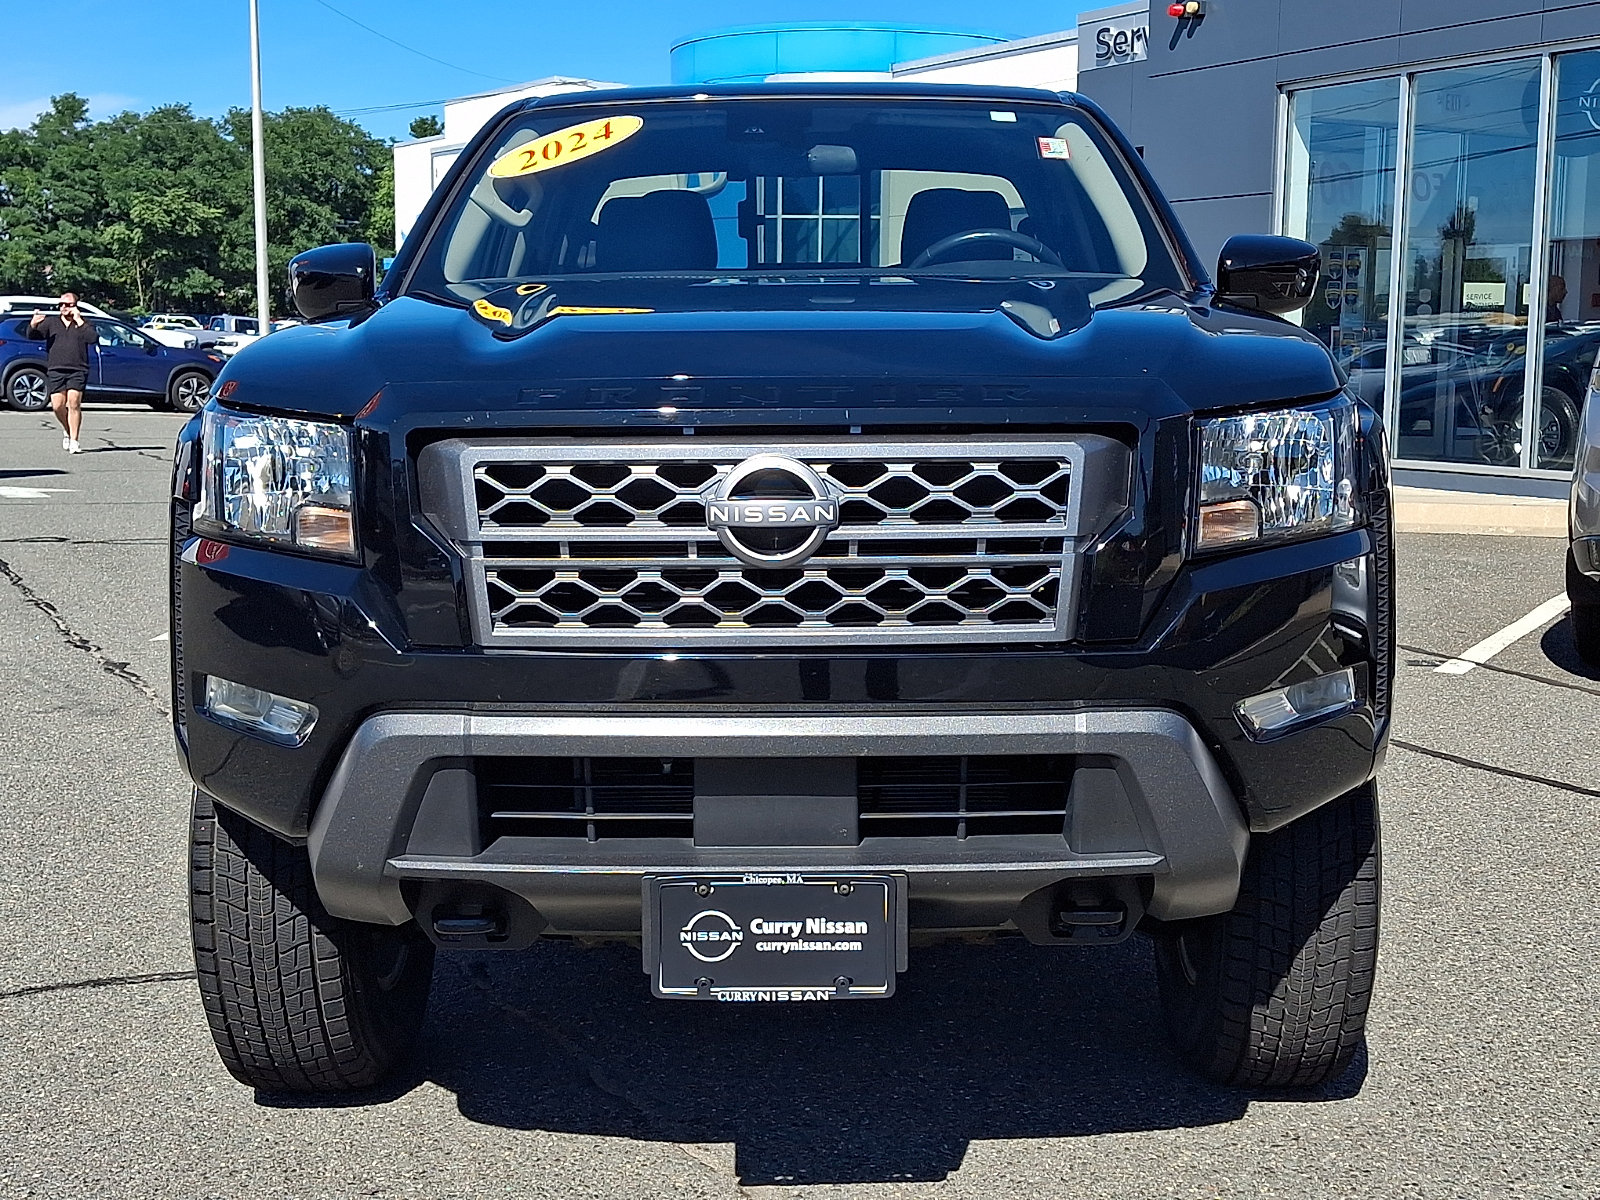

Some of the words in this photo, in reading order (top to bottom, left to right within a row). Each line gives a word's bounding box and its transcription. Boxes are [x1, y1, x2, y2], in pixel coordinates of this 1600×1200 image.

[518, 121, 614, 171] 2024
[516, 386, 1032, 404] FRONTIER
[710, 504, 834, 523] NISSAN
[786, 873, 804, 884] MA
[680, 931, 744, 942] NISSAN
[749, 917, 803, 938] Curry
[805, 917, 868, 935] Nissan
[755, 939, 863, 953] currynissan.com
